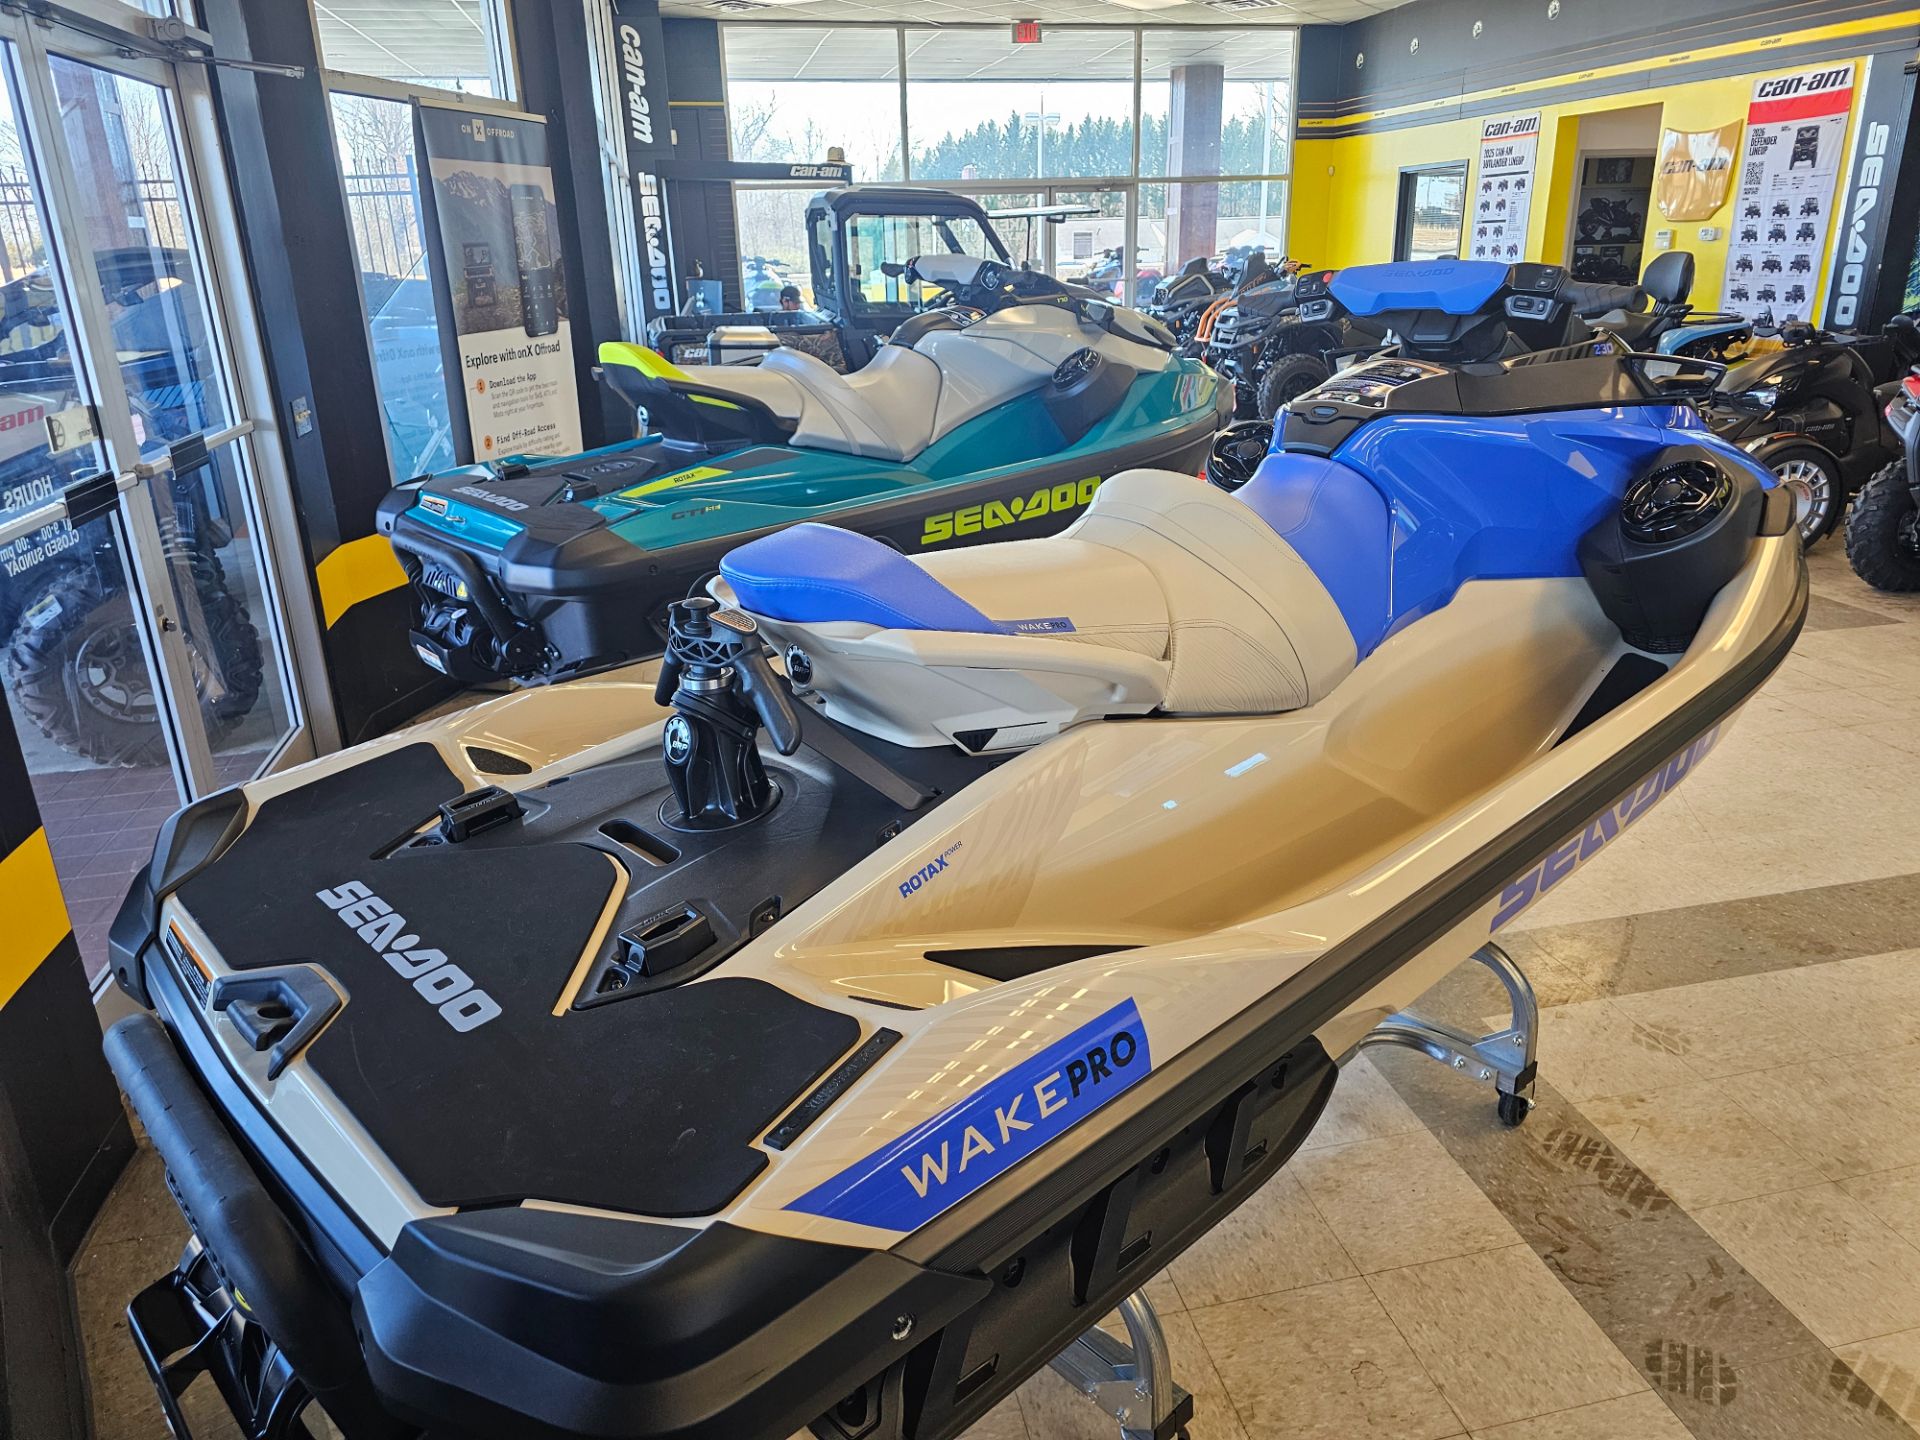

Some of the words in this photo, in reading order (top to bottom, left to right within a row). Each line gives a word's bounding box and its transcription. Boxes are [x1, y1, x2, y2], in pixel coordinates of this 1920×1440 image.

[1017, 23, 1038, 41] EXIT
[619, 24, 653, 144] can-am
[1758, 67, 1850, 98] can-am
[1485, 117, 1537, 136] can-am
[1750, 135, 1778, 146] DEFENDER
[1749, 145, 1768, 156] LINEUP
[1508, 155, 1525, 166] LINEUP
[790, 165, 842, 178] can-am
[465, 352, 498, 369] Explore
[499, 348, 516, 362] with
[518, 345, 533, 359] onX
[535, 340, 561, 356] Offroad
[1593, 342, 1614, 356] 230
[489, 377, 516, 389] Download
[517, 375, 525, 383] the
[527, 372, 537, 381] App
[497, 434, 511, 445] Find
[512, 427, 536, 439] Off-Road
[537, 423, 556, 432] Access
[673, 472, 696, 484] ROTAX
[793, 664, 810, 674] BRP
[672, 740, 688, 750] BRP
[898, 853, 949, 899] ROTAX
[944, 840, 963, 857] POWER
